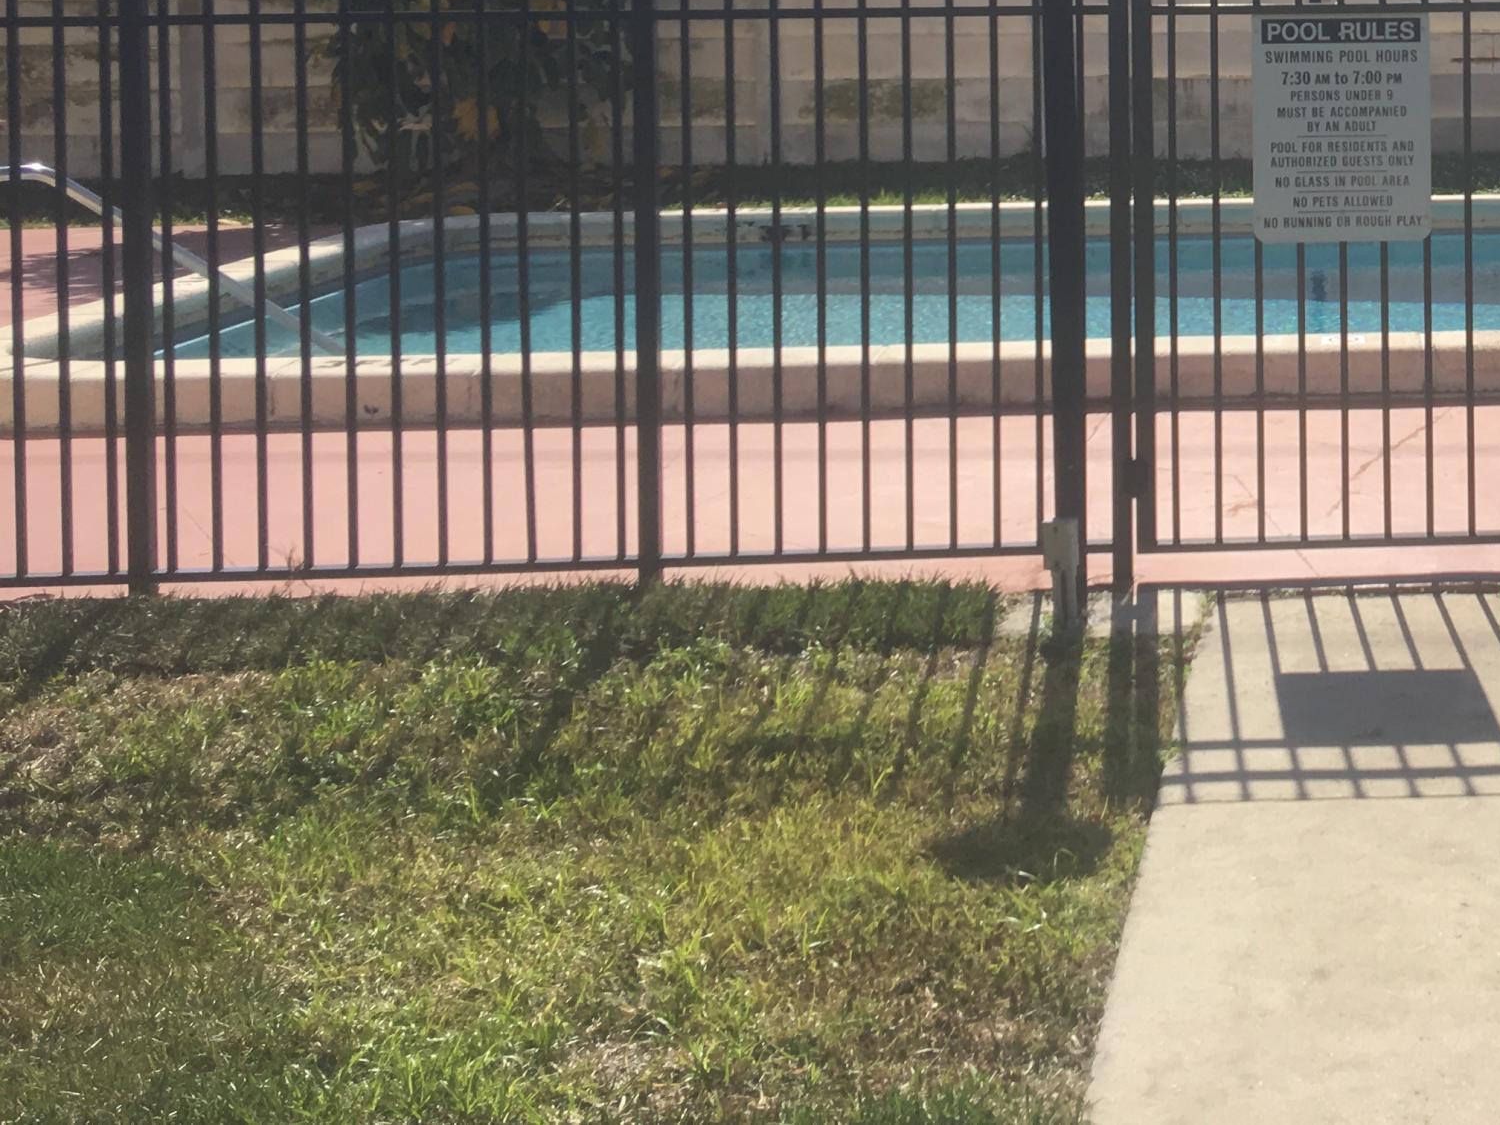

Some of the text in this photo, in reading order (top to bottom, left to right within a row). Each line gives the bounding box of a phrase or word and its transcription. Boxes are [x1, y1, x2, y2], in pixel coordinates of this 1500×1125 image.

[1267, 21, 1415, 41] POOL RULES
[1265, 49, 1418, 64] SWIMMING POOL HOURS
[1281, 71, 1402, 85] 7:30 AM to 7:00 PM
[1290, 89, 1393, 101] PERSONS UNDER 9
[1277, 106, 1408, 118] MUST BE ACCOMPANIED
[1307, 121, 1377, 132] BY AN ADULT
[1270, 141, 1414, 153] POOL FOR RESIDENTS AND
[1270, 155, 1414, 168] AUTHORIZED GUESTS ONLY
[1275, 175, 1410, 188] NO GLASS IN POOL AREA
[1293, 195, 1392, 208] NO PETS ALLOWED
[1263, 215, 1422, 228] NO RUNNING OR ROUGH PLAY
